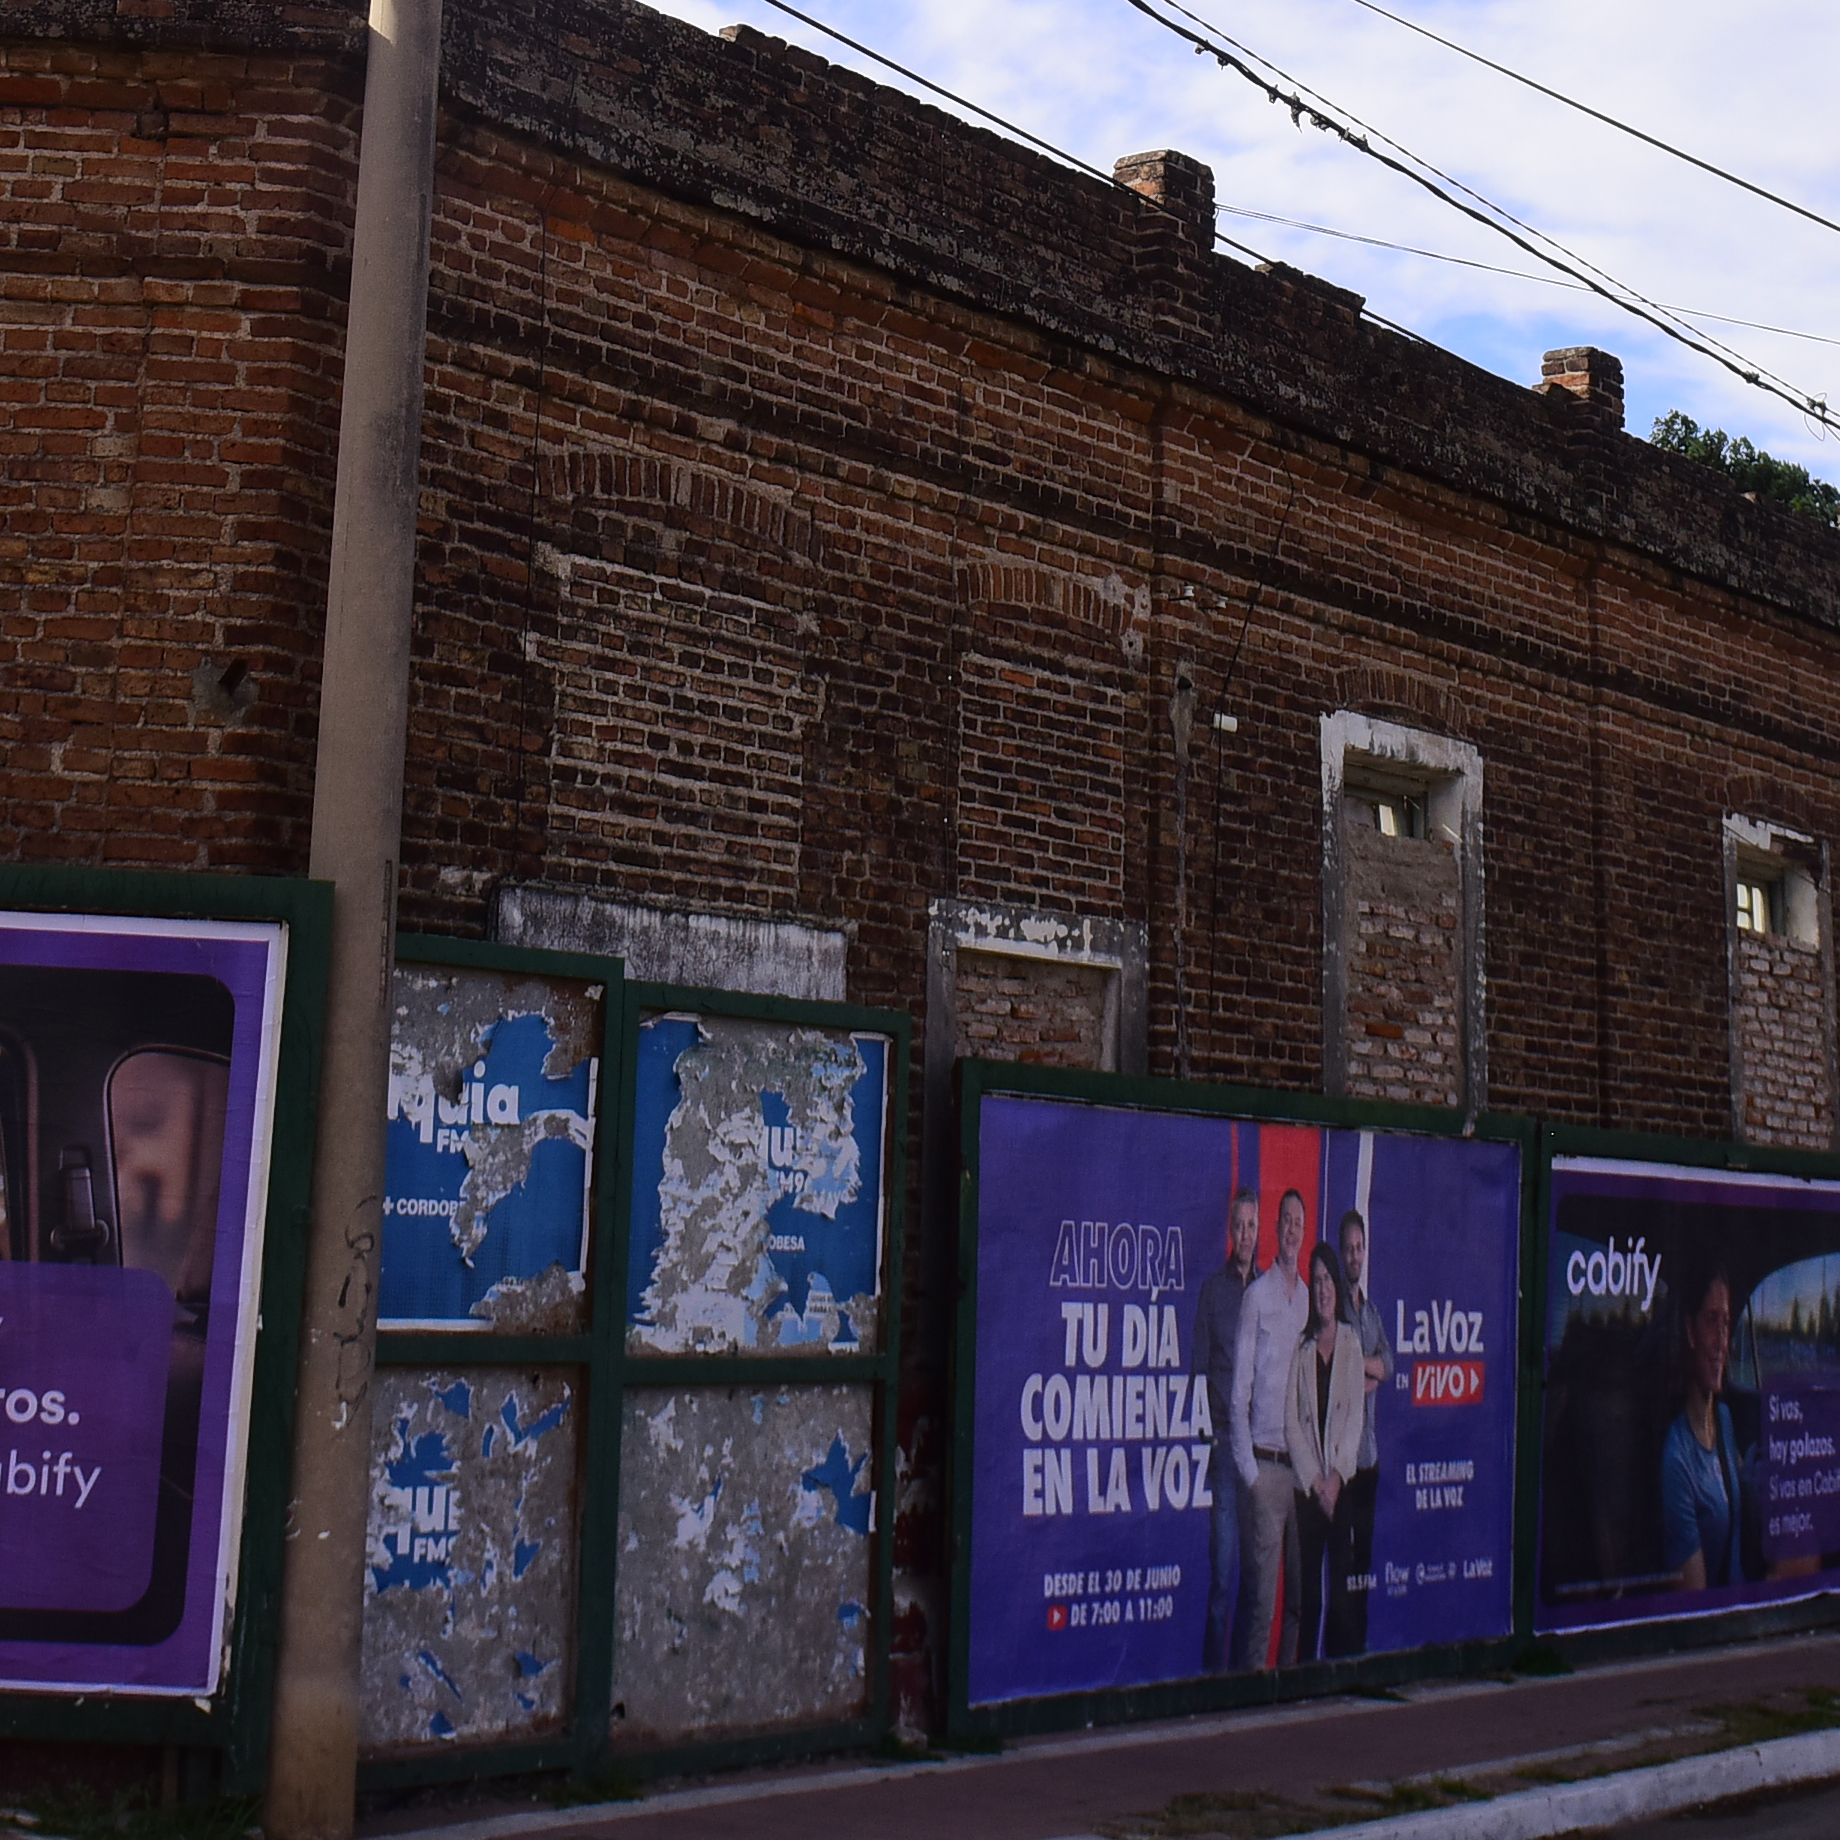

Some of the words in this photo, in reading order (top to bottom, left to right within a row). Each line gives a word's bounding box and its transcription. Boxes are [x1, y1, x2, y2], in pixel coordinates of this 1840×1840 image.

[1049, 1220, 1185, 1291] AHORA
[1566, 1236, 1662, 1311] cabify
[1061, 1302, 1109, 1368] TU
[1121, 1285, 1180, 1368] DÍA
[1020, 1373, 1214, 1441] COMIENZA
[1023, 1447, 1073, 1516] EN
[1086, 1446, 1132, 1514] LA
[1141, 1444, 1214, 1511] VOZ
[1406, 1463, 1416, 1485] EL
[1419, 1460, 1475, 1484] STREAMING
[1416, 1488, 1428, 1510] DE
[1430, 1487, 1442, 1509] LA
[1443, 1485, 1464, 1508] VOZ
[1043, 1571, 1085, 1598] DESDE
[1087, 1569, 1101, 1594] EL
[1104, 1568, 1123, 1593] 30
[1126, 1566, 1142, 1591] DE
[1144, 1563, 1181, 1591] JUNIO
[1070, 1602, 1088, 1627] DE
[1091, 1599, 1121, 1626] 7:00
[1124, 1598, 1134, 1623] A
[1139, 1594, 1174, 1622] 11:00
